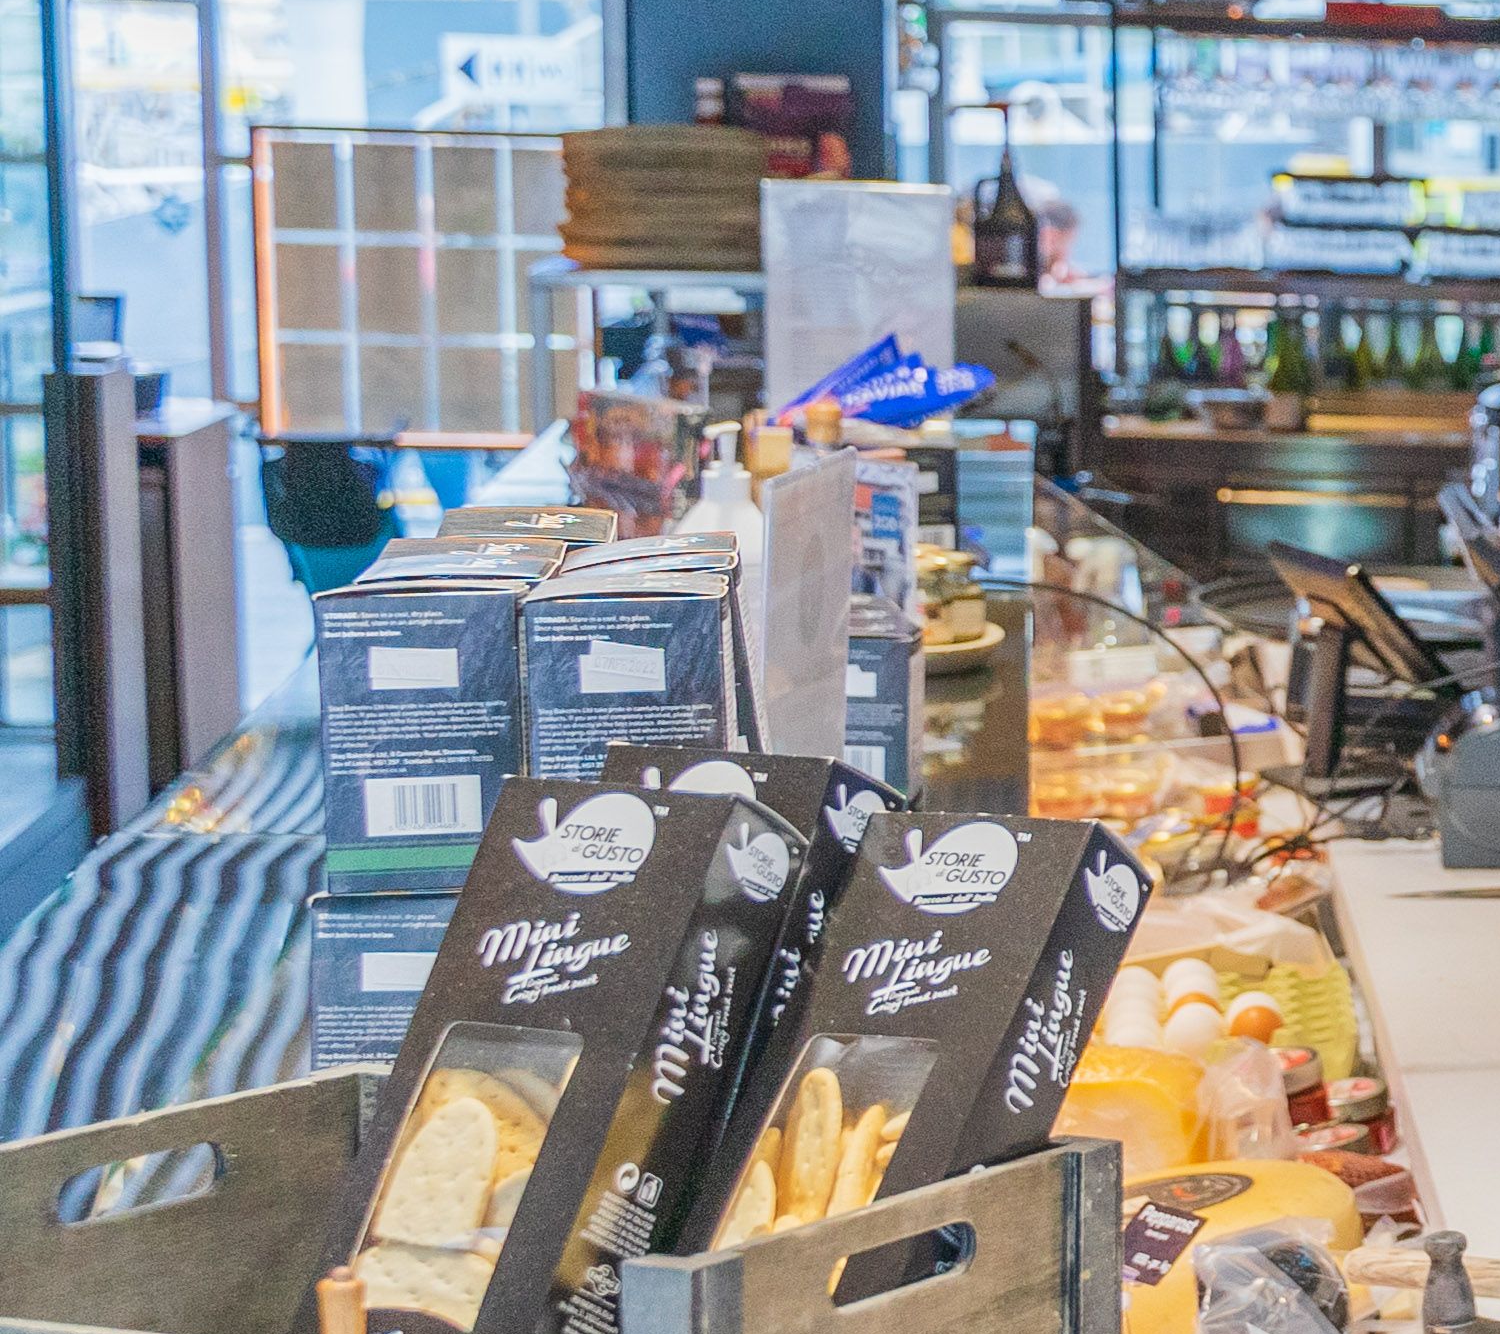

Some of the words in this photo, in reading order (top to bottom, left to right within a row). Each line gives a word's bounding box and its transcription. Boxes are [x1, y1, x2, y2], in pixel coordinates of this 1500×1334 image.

[560, 823, 621, 844] STORIE
[582, 844, 646, 865] GUSTO
[924, 851, 987, 867] STORIE
[946, 868, 1007, 886] GUSTO
[478, 911, 583, 967] Mini
[841, 929, 944, 984] Mini
